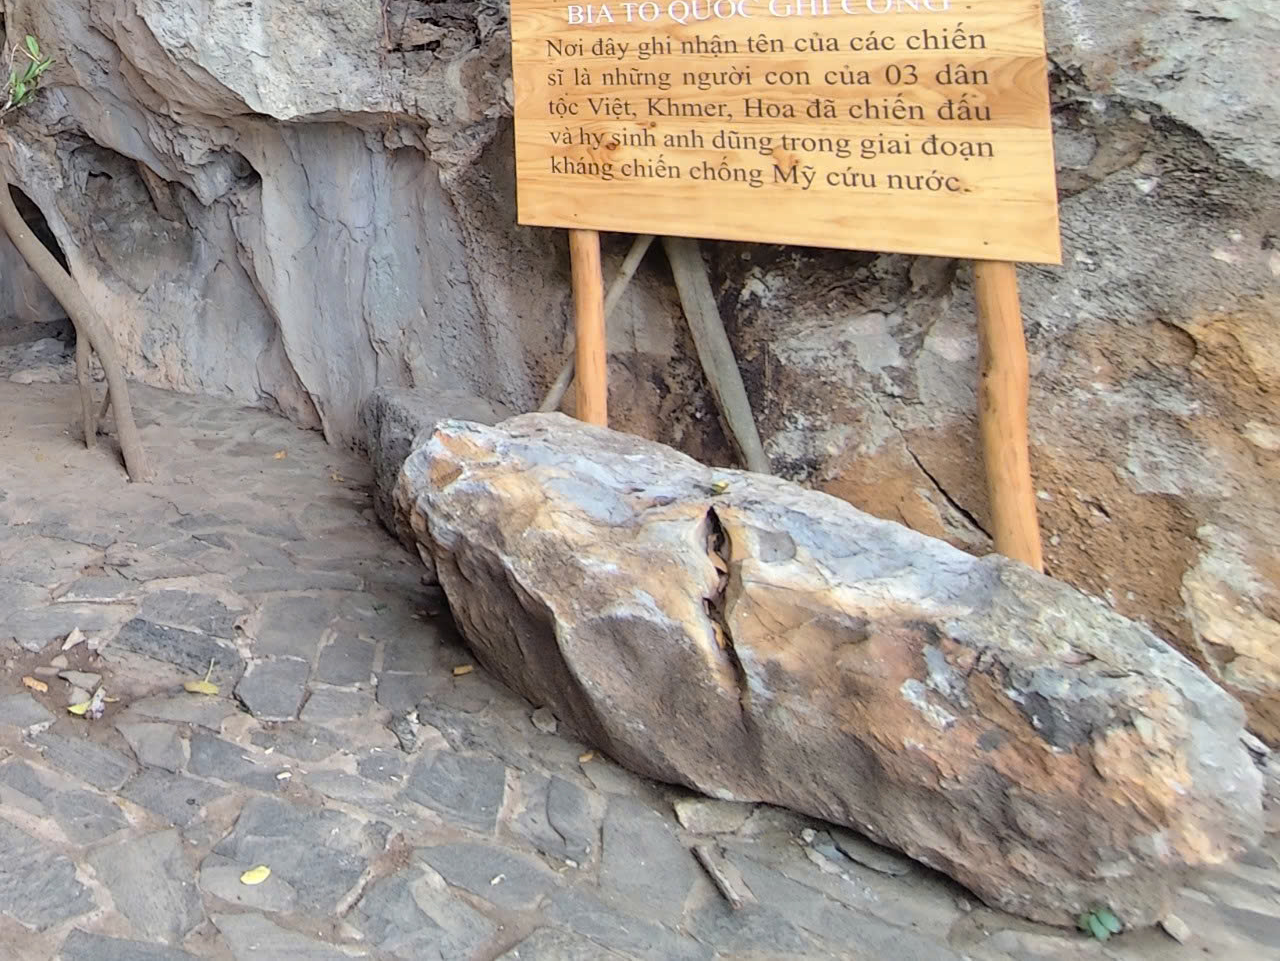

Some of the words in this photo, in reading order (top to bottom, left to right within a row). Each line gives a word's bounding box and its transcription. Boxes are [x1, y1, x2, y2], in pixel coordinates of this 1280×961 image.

[567, 4, 614, 25] BIA
[546, 38, 583, 57] Nơi
[591, 38, 629, 60] đây
[638, 36, 671, 60] ghi
[681, 34, 738, 58] nhận
[748, 33, 784, 53] tên
[794, 32, 839, 52] của
[850, 30, 895, 51] các
[906, 22, 986, 50] chiến
[547, 68, 564, 87] sĩ
[575, 67, 591, 86] là
[601, 67, 671, 91] những
[682, 65, 752, 91] người
[764, 68, 811, 86] con
[824, 64, 872, 86] của
[885, 64, 918, 86] 03
[935, 64, 989, 85] dân
[548, 97, 579, 118] tộc
[586, 97, 637, 120] Việt,
[646, 97, 733, 120] Khmer,
[744, 98, 796, 119] Hoa
[806, 98, 837, 119] đã
[848, 93, 925, 120] chiến
[937, 93, 992, 121] đấu
[549, 127, 572, 145] và
[579, 127, 605, 150] hy
[611, 128, 656, 147] sinh
[663, 129, 704, 149] anh
[712, 130, 775, 155] dũng
[781, 134, 852, 158] trong
[860, 133, 912, 159] giai
[921, 134, 994, 162] đoạn
[551, 156, 615, 181] kháng
[621, 153, 681, 179] chiến
[689, 156, 764, 188] chống
[771, 161, 817, 190] Mỹ
[826, 167, 878, 188] cứu
[887, 169, 971, 193] nước.
